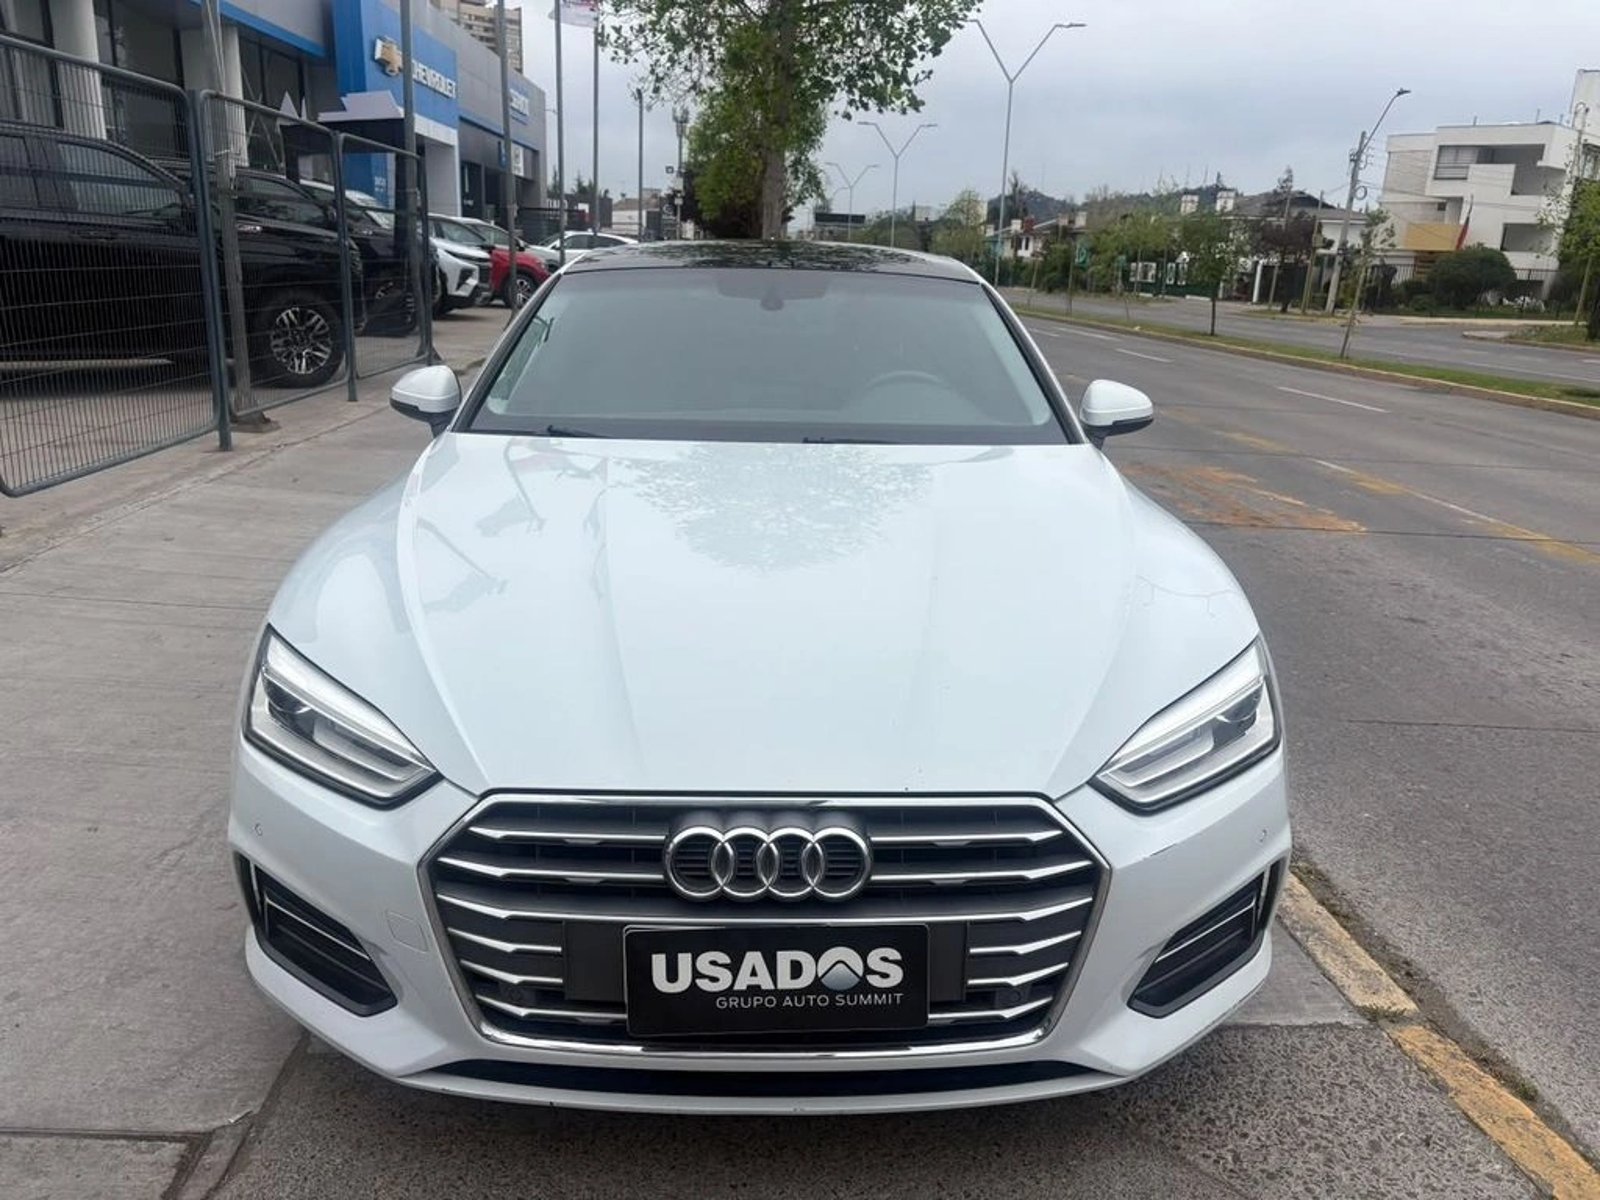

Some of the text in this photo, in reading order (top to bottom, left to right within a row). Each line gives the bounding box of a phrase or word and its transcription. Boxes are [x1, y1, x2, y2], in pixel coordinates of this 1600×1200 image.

[651, 946, 904, 993] USADOS
[716, 993, 904, 1009] GRUPO AUTO SUMMIT
